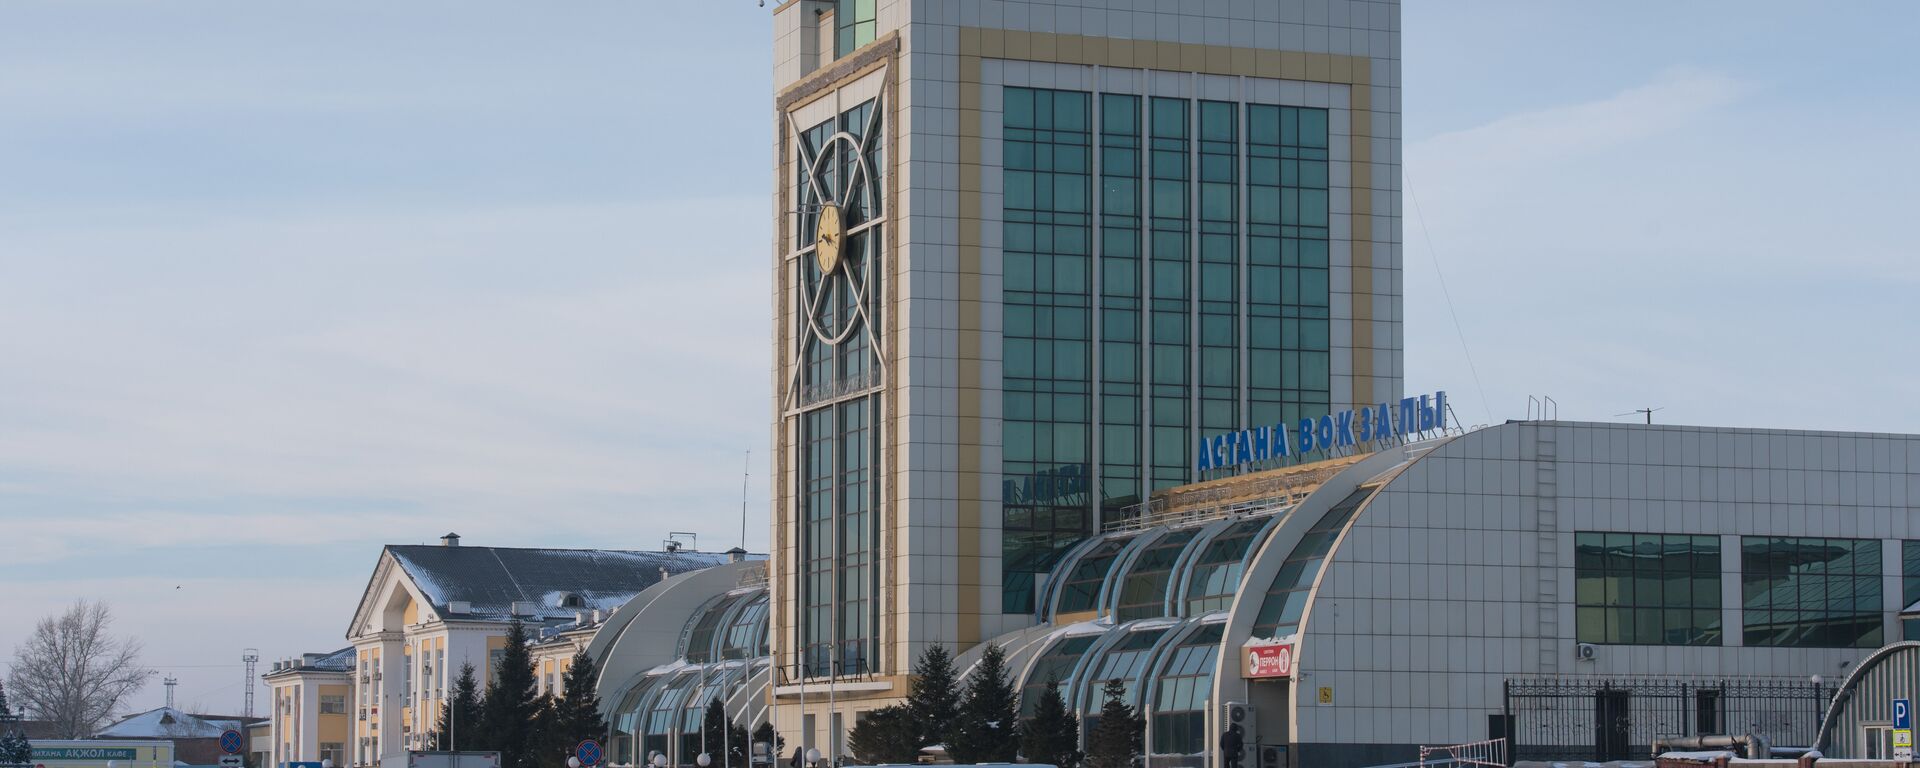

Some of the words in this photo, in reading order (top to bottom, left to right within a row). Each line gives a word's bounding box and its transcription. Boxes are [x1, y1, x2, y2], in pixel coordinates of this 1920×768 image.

[1198, 423, 1290, 471] АСТАНА
[1300, 391, 1446, 454] ВОКЗАЛЫ
[1259, 656, 1279, 667] ПЕРРОН
